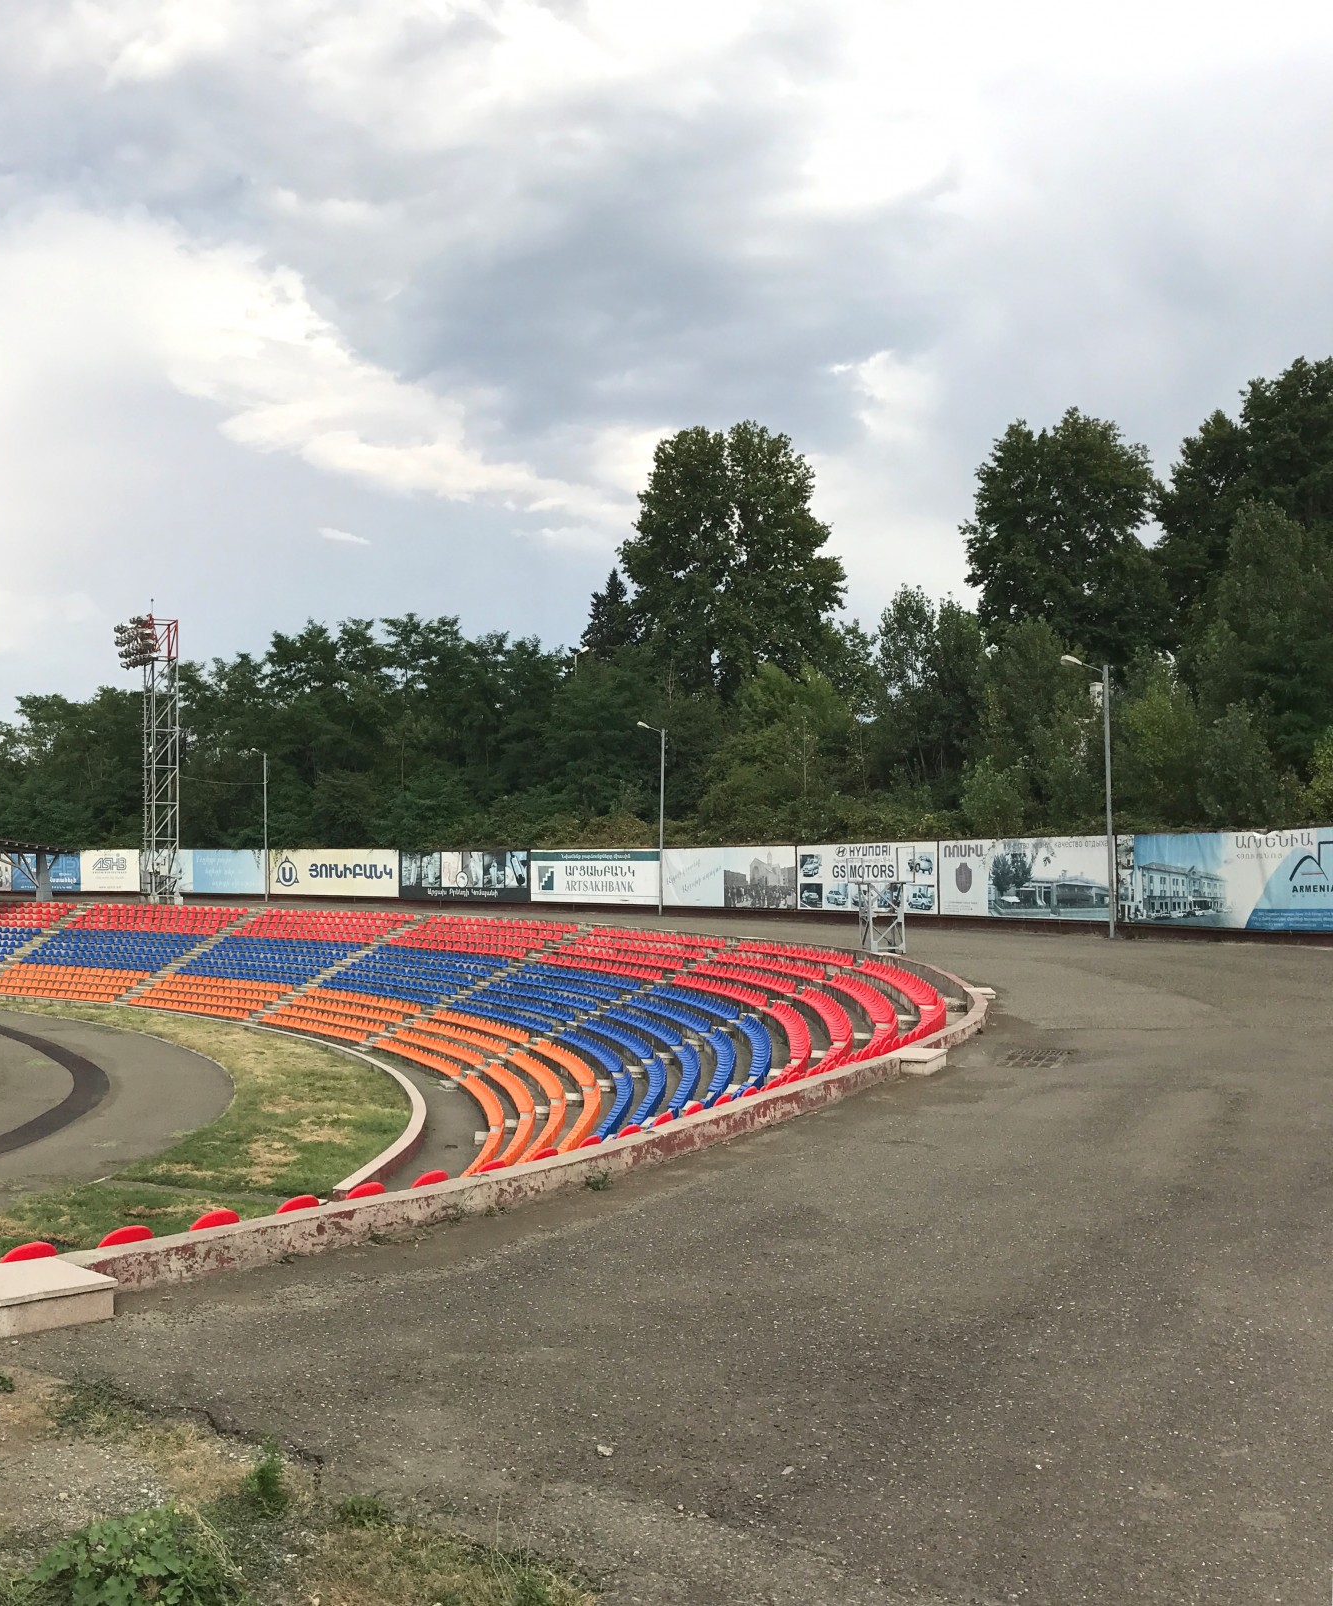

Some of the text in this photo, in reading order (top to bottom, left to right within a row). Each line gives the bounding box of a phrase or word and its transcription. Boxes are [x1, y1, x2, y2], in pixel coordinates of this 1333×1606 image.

[849, 845, 891, 857] HYUNDAI
[944, 844, 983, 858] ՌՈՍԻԱ
[281, 866, 293, 883] U
[308, 863, 393, 880] ՅՈՒՆԻԲԱՆԿ
[565, 865, 635, 877] ԱՐՑԱԽԲԱՆԿ
[832, 864, 894, 878] GS MOTORS
[565, 880, 635, 893] ARTSAKHBANK
